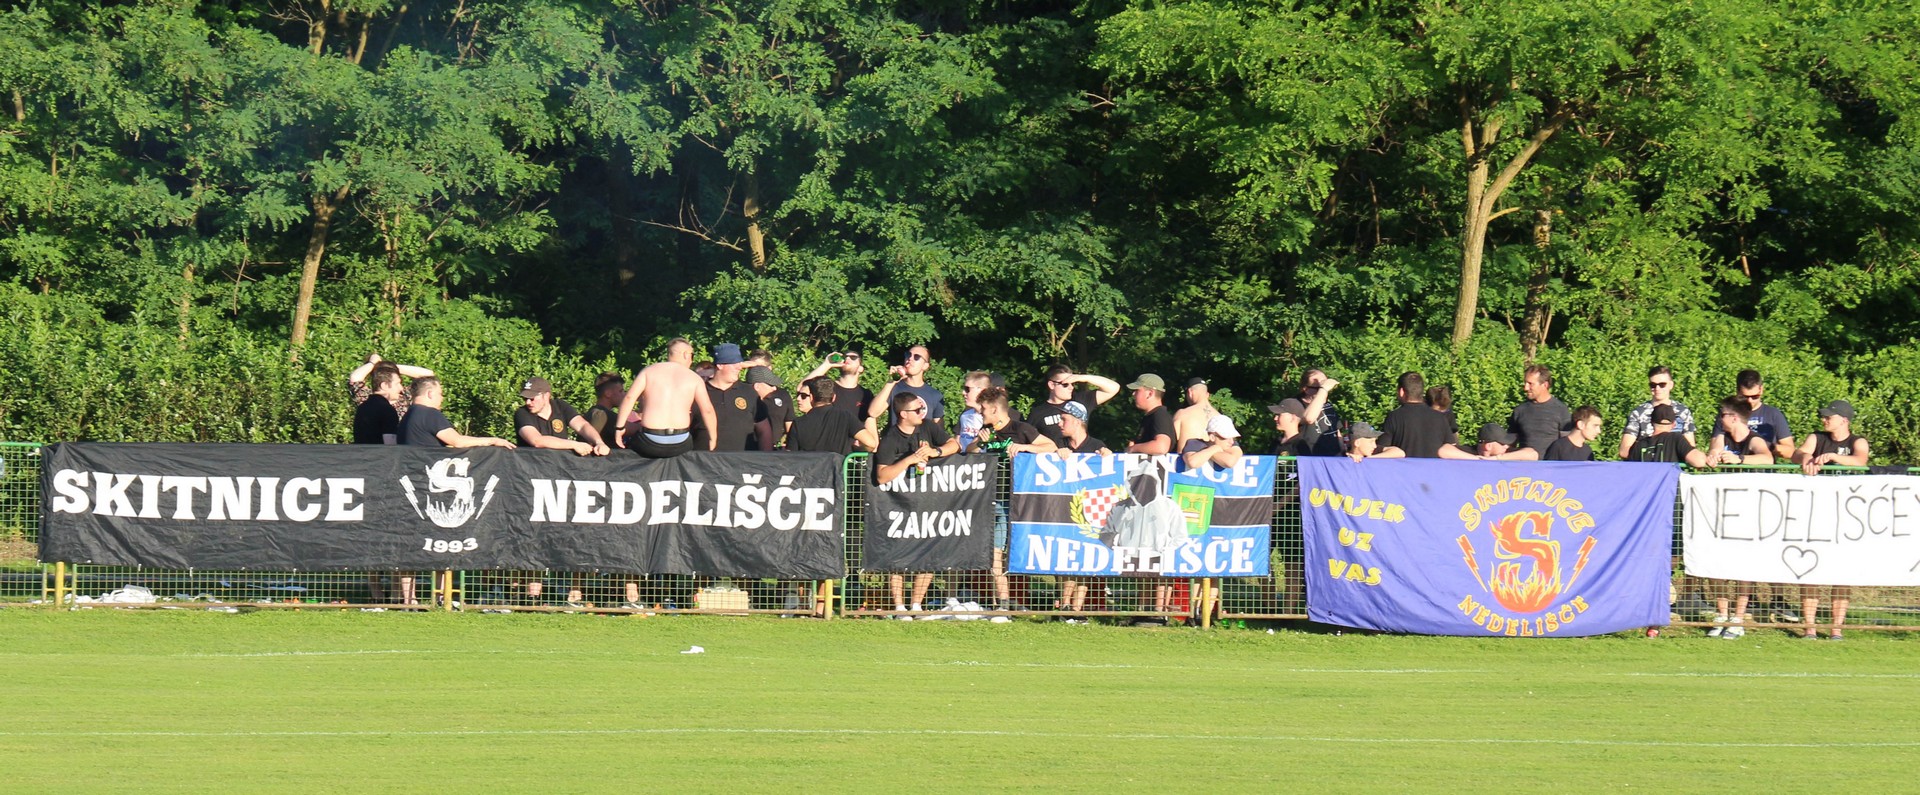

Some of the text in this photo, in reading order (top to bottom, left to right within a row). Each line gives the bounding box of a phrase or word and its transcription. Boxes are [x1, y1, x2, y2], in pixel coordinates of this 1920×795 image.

[52, 469, 835, 531] SKITNICE NEDELIŠĆE
[1309, 487, 1406, 524] UVIJEK
[1458, 477, 1596, 534] SKITNICE
[1689, 484, 1911, 544] NEDELIŠĆE
[887, 509, 973, 539] ZAKON
[1338, 527, 1374, 552] UZ
[422, 537, 478, 553] 1993
[1328, 558, 1382, 586] VAS
